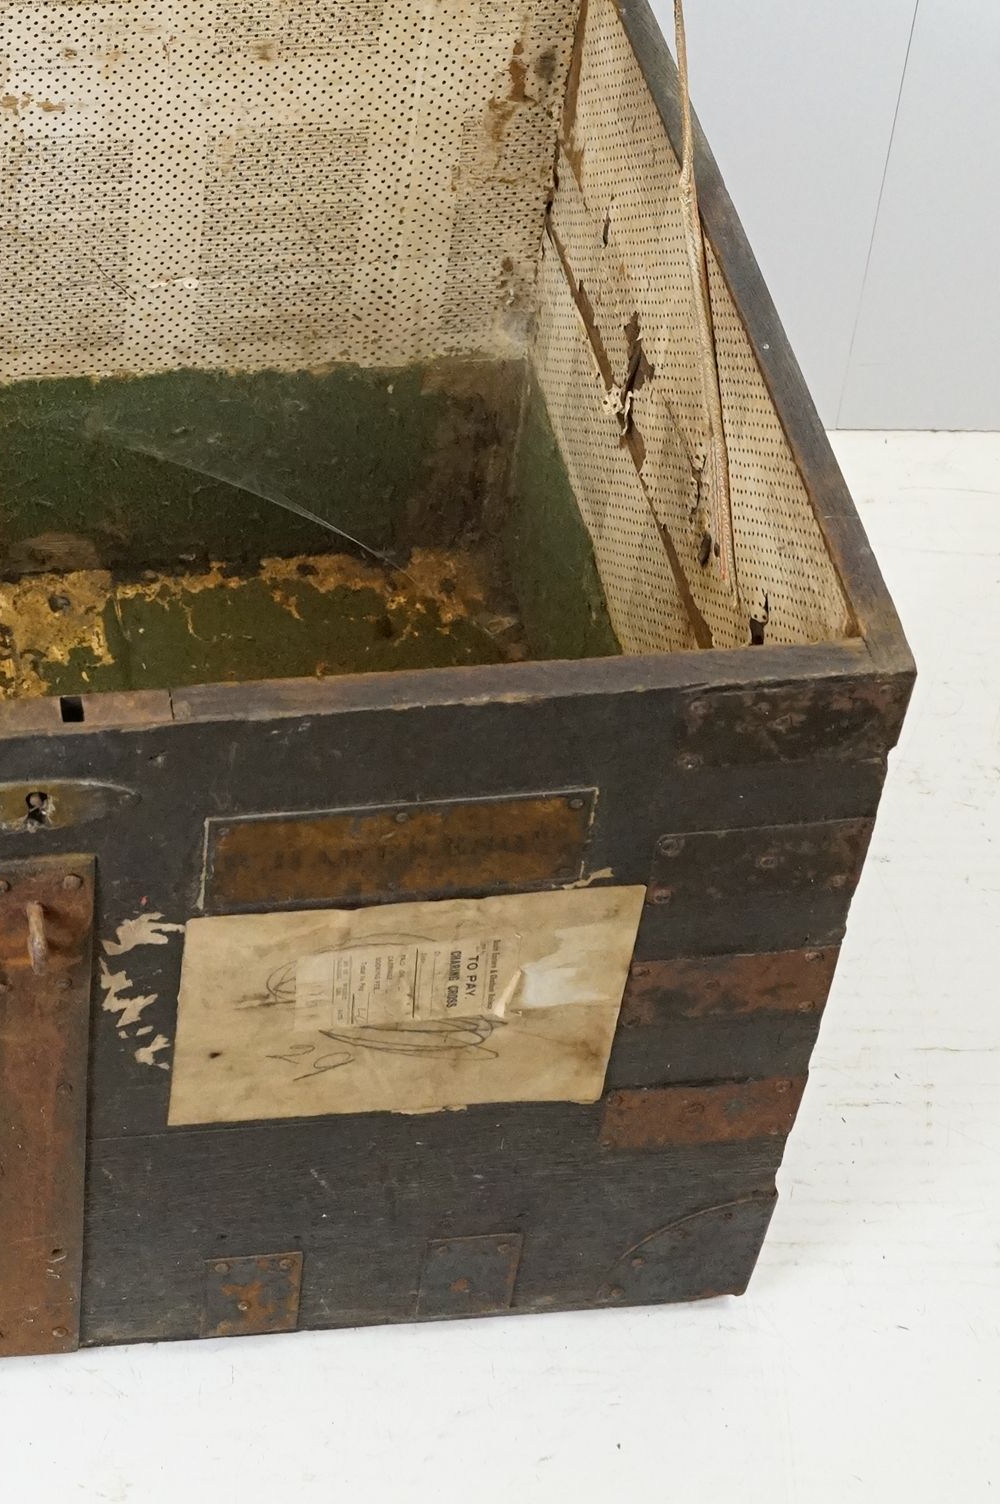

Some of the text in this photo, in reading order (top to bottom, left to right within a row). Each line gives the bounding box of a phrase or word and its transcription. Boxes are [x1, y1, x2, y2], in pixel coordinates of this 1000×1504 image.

[446, 950, 462, 1008] CHARING CROSS
[467, 955, 479, 971] TO
